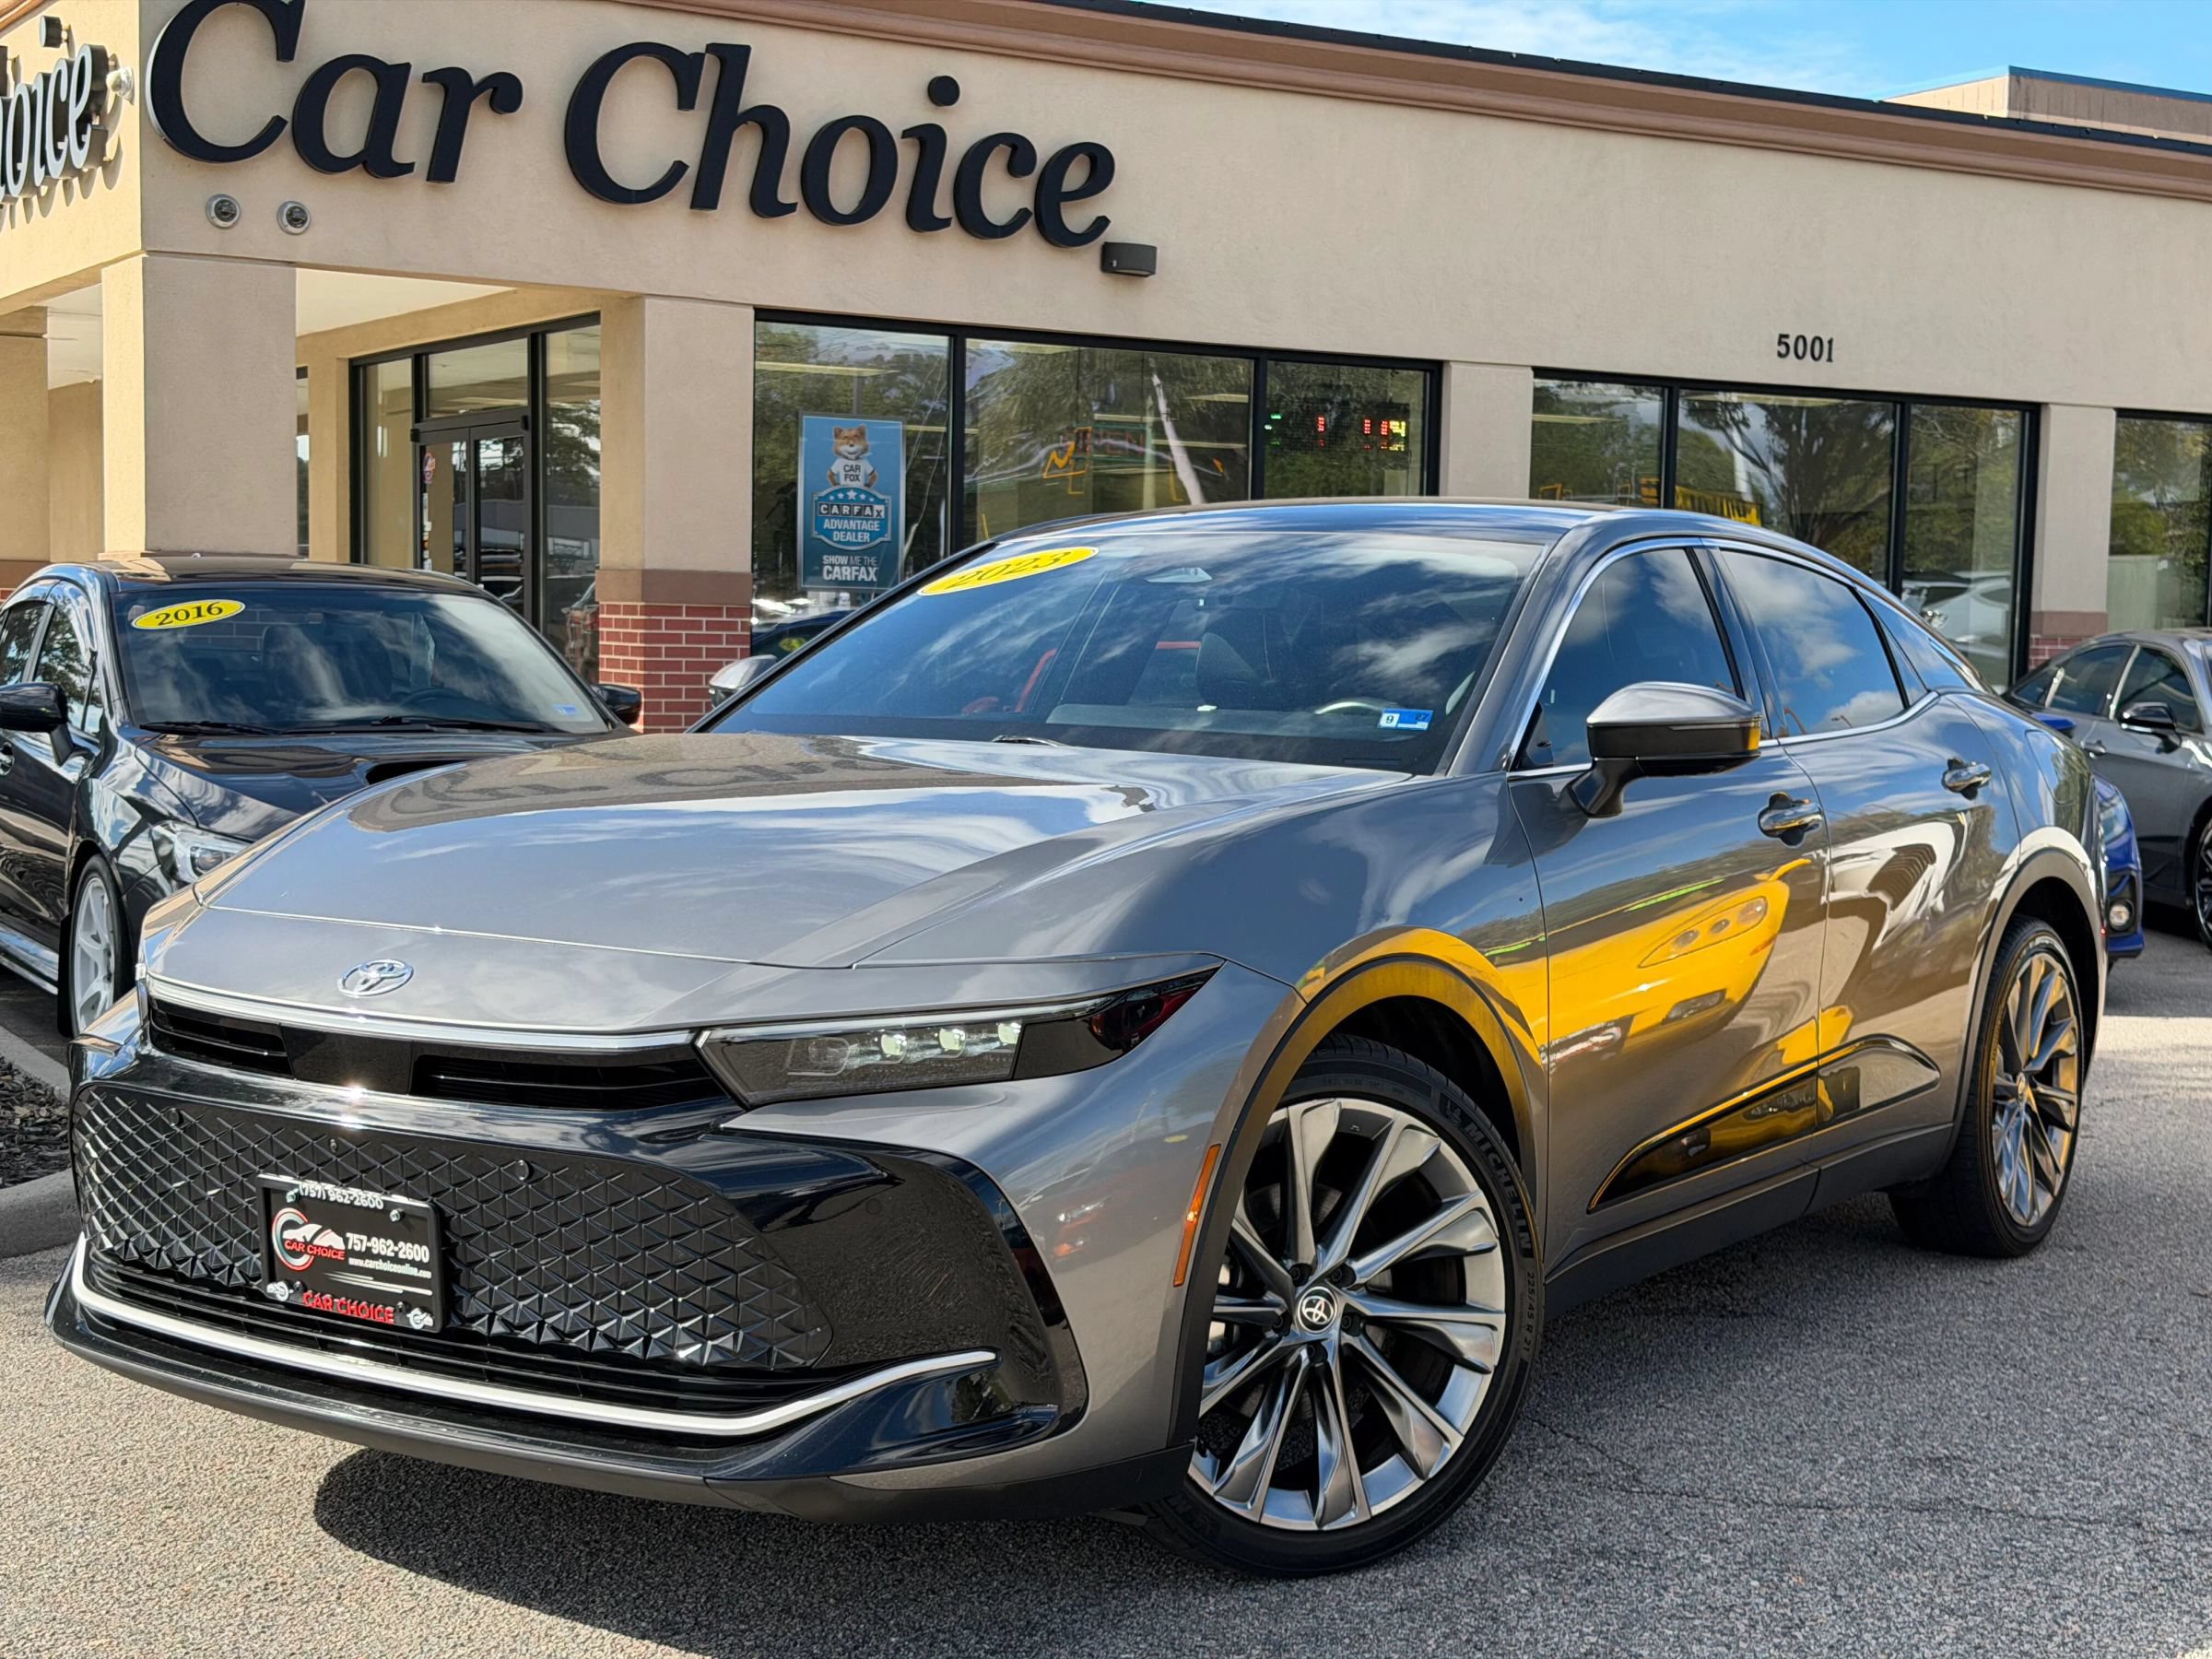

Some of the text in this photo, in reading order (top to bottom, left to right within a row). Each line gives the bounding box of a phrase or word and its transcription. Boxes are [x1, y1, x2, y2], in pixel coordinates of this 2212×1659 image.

[146, 0, 1116, 249] Car Choice
[1777, 333, 1834, 362] 5001
[843, 464, 861, 474] CAR
[843, 473, 861, 482] FOX
[820, 504, 884, 518] CARFAX
[823, 519, 880, 531] ADVANTAGE
[832, 532, 870, 543] DEALER
[822, 555, 878, 567] SHOW ME THE
[944, 551, 1072, 590] 2023
[822, 566, 878, 582] CARFAX
[155, 602, 223, 626] 2016
[1385, 715, 1394, 724] 9
[1465, 1121, 1534, 1253] MICHELIN
[284, 1240, 346, 1261] CAR CHOICE
[346, 1232, 430, 1264] 757-962-2600
[302, 1289, 394, 1324] CAR CHOICE
[1525, 1272, 1535, 1320] 225/45
